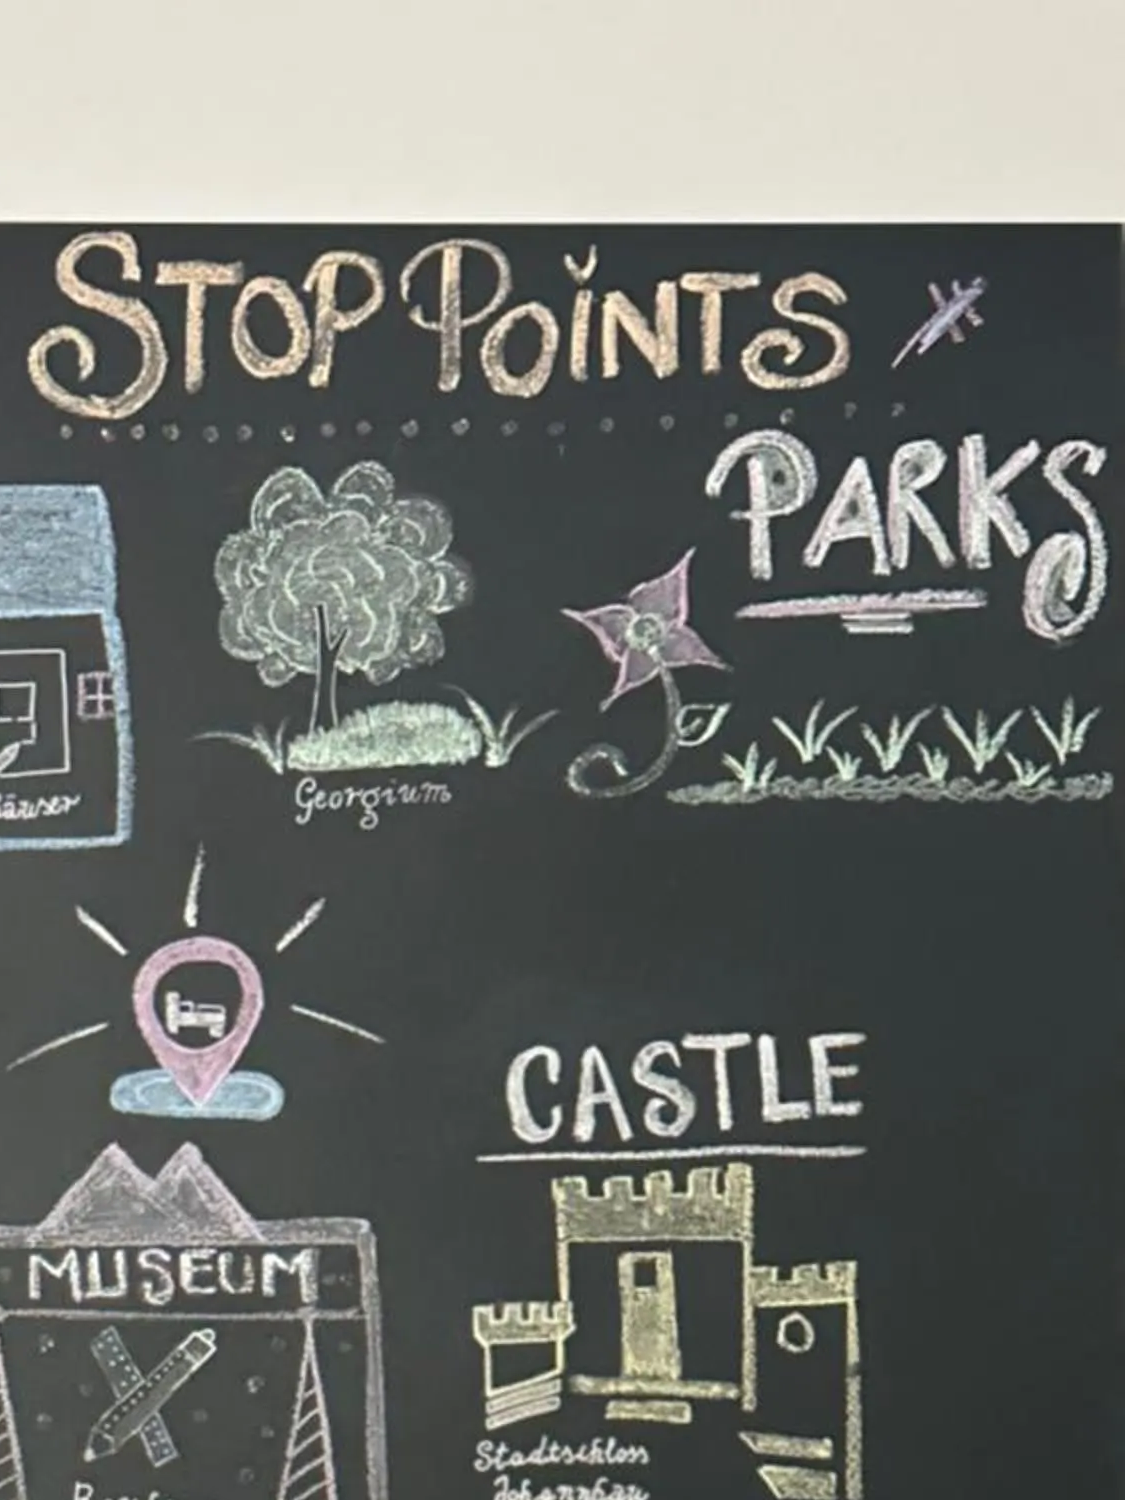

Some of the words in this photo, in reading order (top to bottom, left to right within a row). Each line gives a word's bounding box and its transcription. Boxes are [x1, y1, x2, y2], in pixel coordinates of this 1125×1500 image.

[27, 231, 385, 420] STOP
[706, 428, 1107, 642] PARKS
[294, 776, 452, 830] Georgium
[505, 1032, 868, 1144] CASTLE
[28, 1248, 319, 1305] MUSEUM
